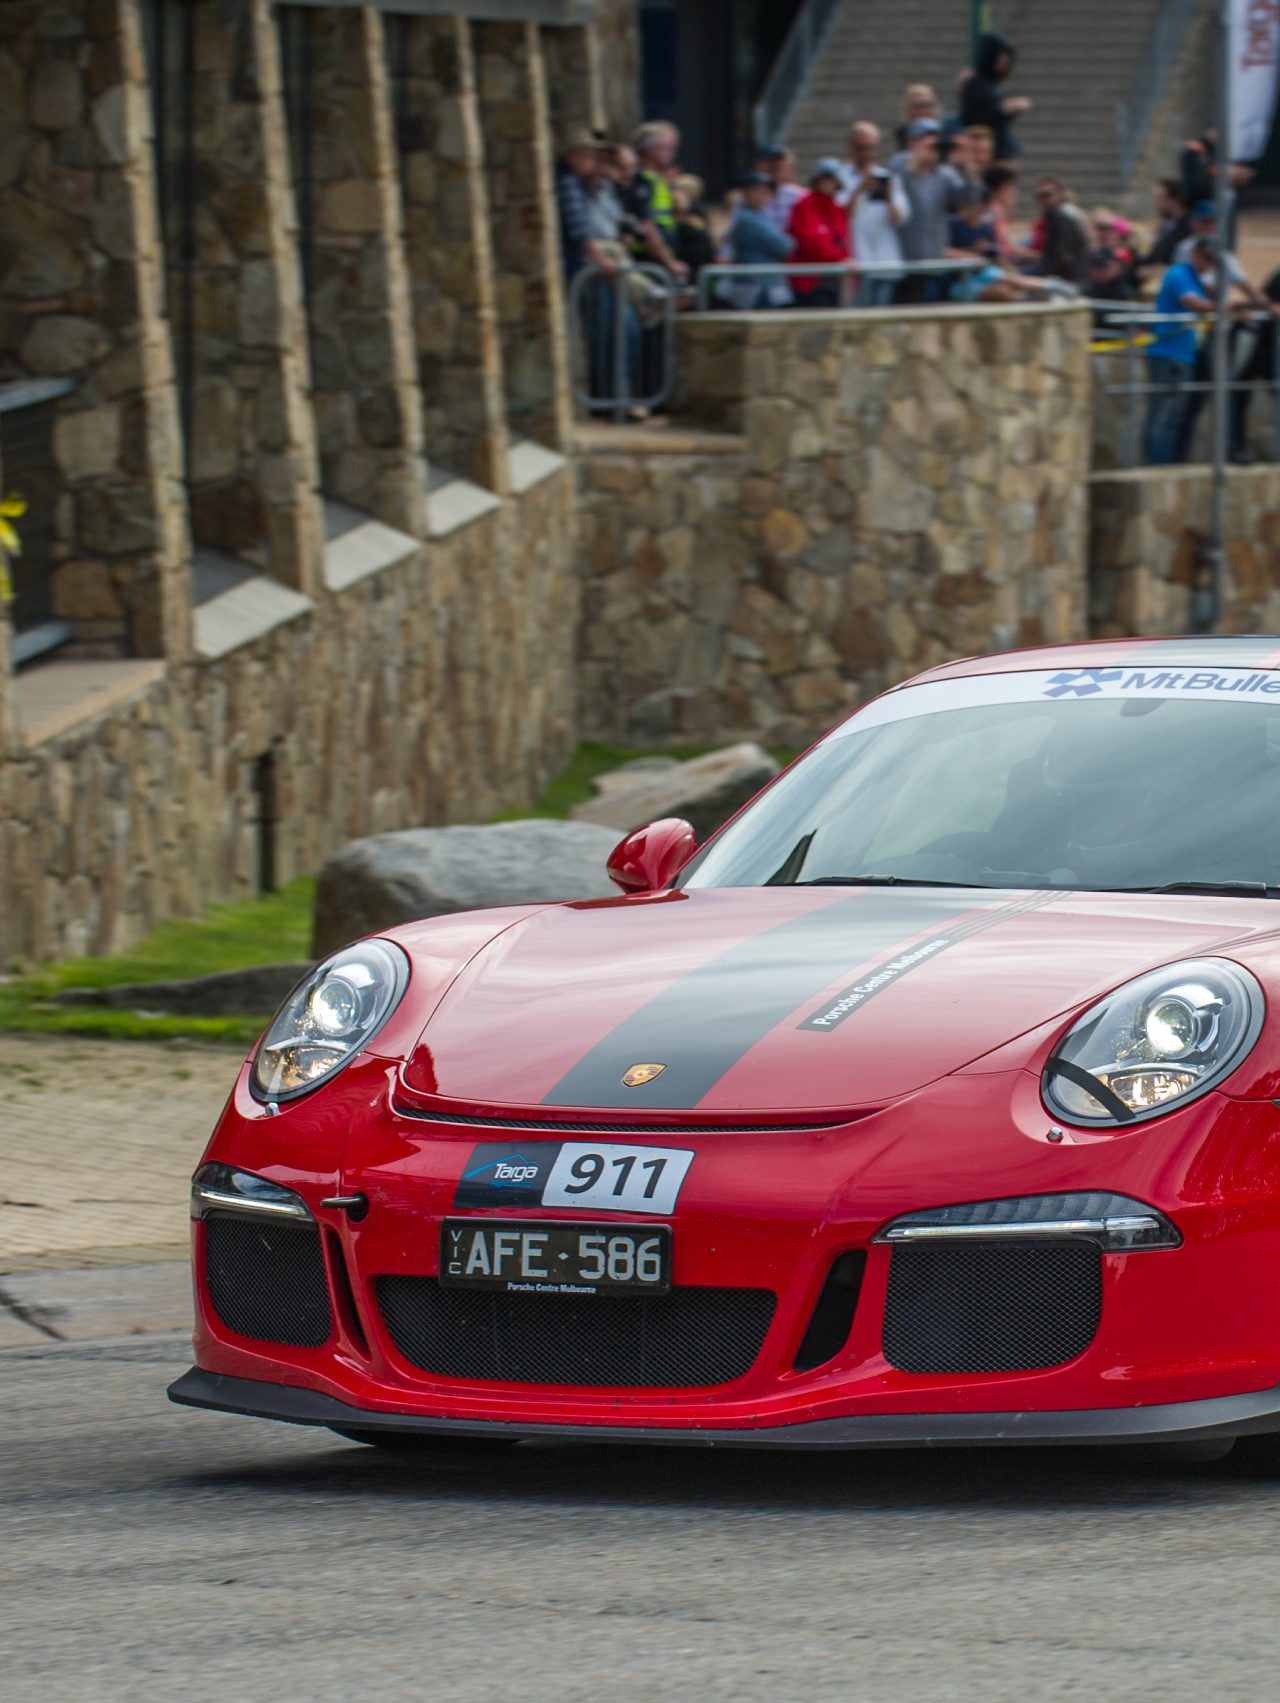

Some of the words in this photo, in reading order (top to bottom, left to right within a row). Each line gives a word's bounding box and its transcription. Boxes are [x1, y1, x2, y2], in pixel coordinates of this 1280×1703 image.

[812, 992, 864, 1025] Porsche
[853, 969, 898, 993] Centre
[494, 1163, 538, 1181] Targa
[564, 1153, 668, 1199] 911
[465, 1231, 549, 1278] AFE
[578, 1235, 662, 1282] 586
[507, 1282, 535, 1291] Porsche
[536, 1283, 559, 1292] Centre
